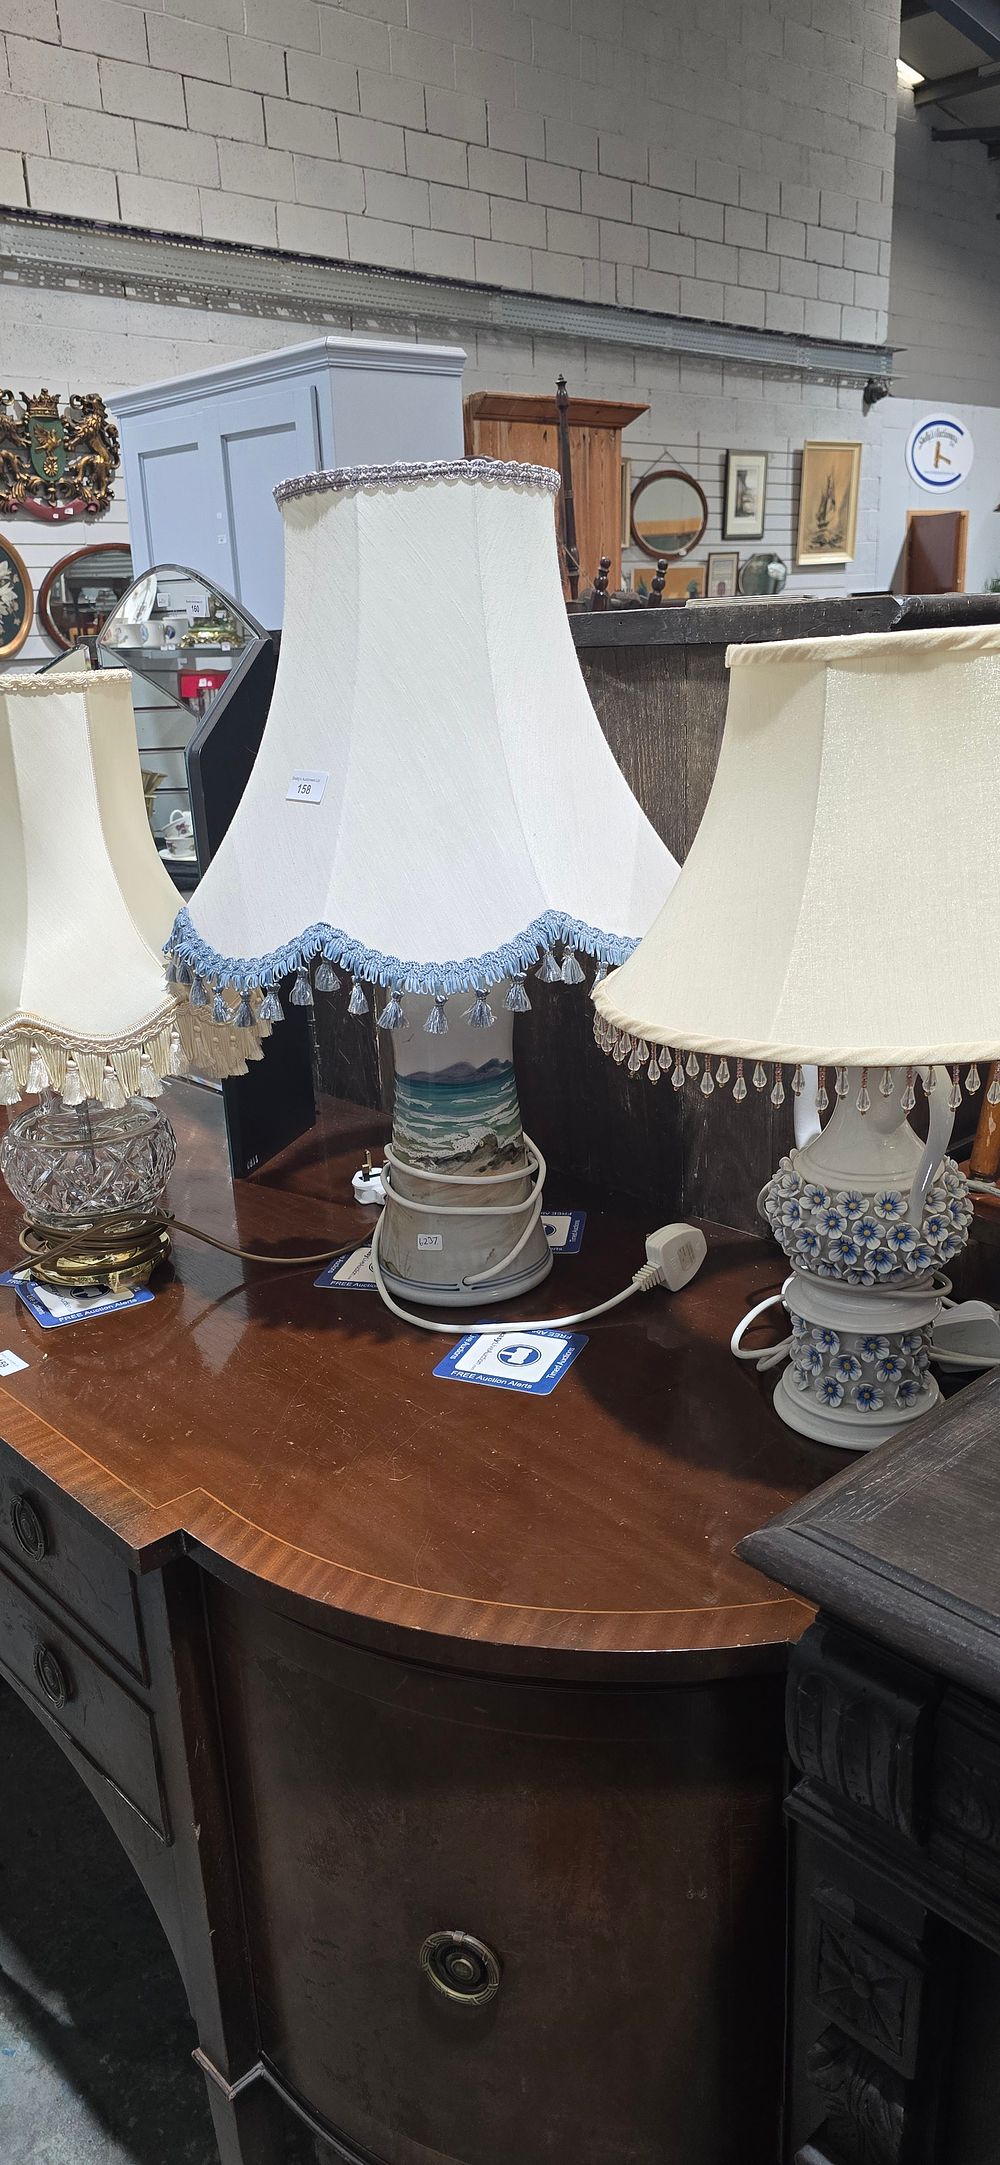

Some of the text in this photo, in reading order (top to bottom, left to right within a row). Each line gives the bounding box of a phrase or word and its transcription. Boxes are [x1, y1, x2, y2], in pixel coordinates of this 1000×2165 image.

[191, 605, 200, 613] 160
[297, 784, 312, 795] 158
[58, 1298, 138, 1322] FREE Auction Alerts
[548, 1332, 573, 1340] FREE
[546, 1347, 576, 1379] Timed Auctions
[450, 1370, 533, 1390] FREE Auction Alerts
